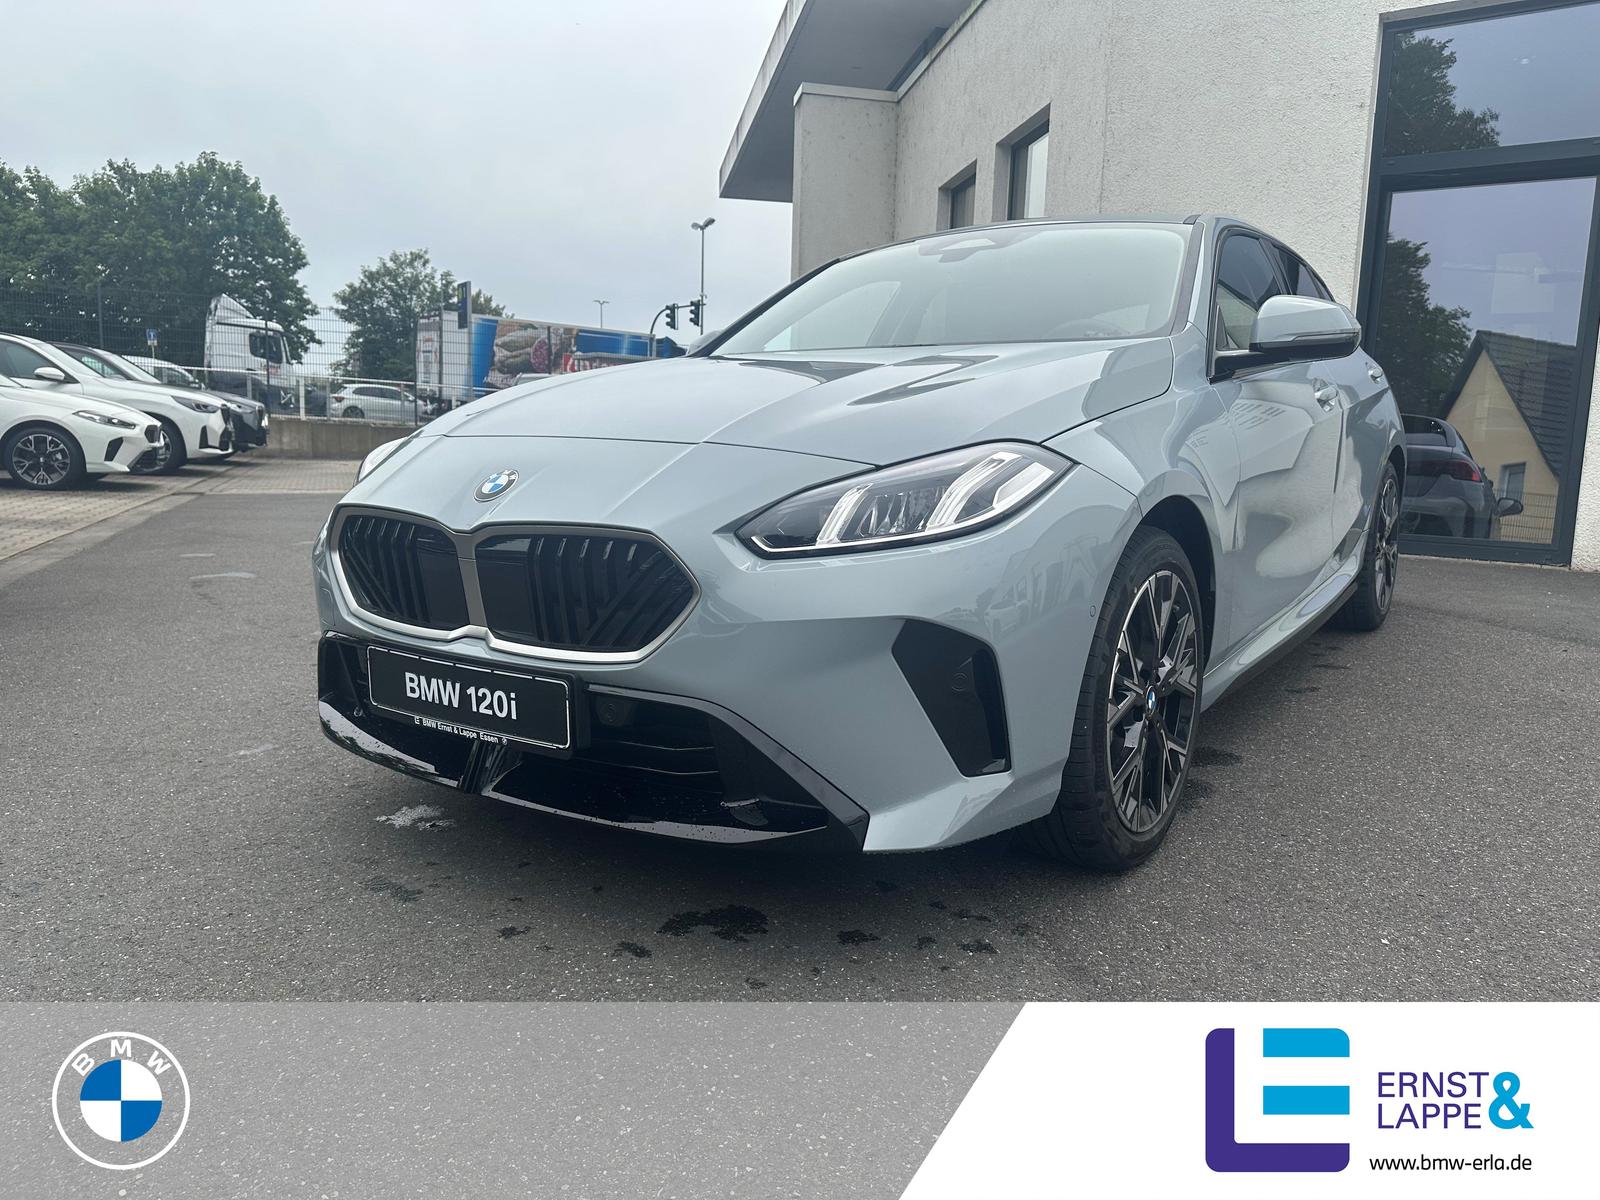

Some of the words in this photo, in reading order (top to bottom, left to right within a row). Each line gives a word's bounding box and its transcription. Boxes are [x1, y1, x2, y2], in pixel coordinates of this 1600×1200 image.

[405, 671, 460, 708] BMW
[466, 686, 517, 720] 120i
[422, 717, 437, 729] BMW
[437, 722, 453, 733] Ernst
[459, 727, 477, 739] Lappe
[480, 732, 499, 744] Essen
